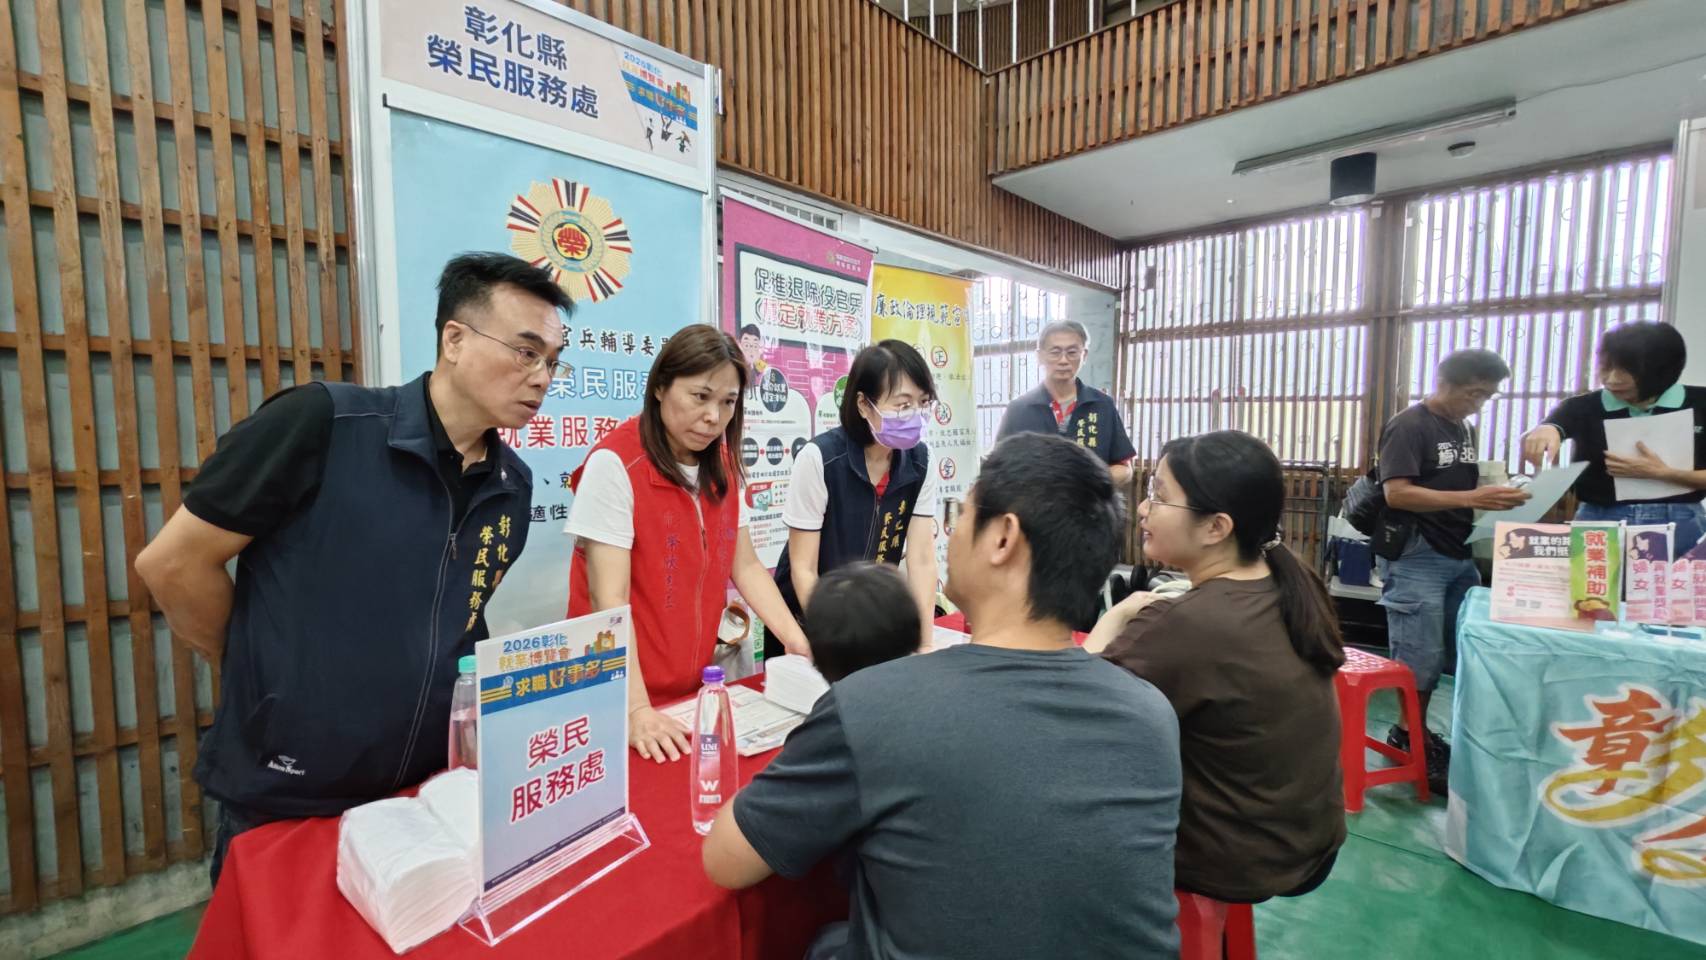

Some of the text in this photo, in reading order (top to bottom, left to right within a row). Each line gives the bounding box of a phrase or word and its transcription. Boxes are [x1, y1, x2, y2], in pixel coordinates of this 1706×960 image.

[464, 5, 568, 71] 彰化縣
[427, 34, 599, 120] 榮民服務處
[755, 267, 863, 313] 促進退除役官兵
[547, 366, 650, 400] 榮民服
[503, 632, 568, 653] 2026彰化
[515, 659, 601, 697] 求職好事多
[528, 716, 590, 768] 榮民
[511, 750, 605, 822] 服務處
